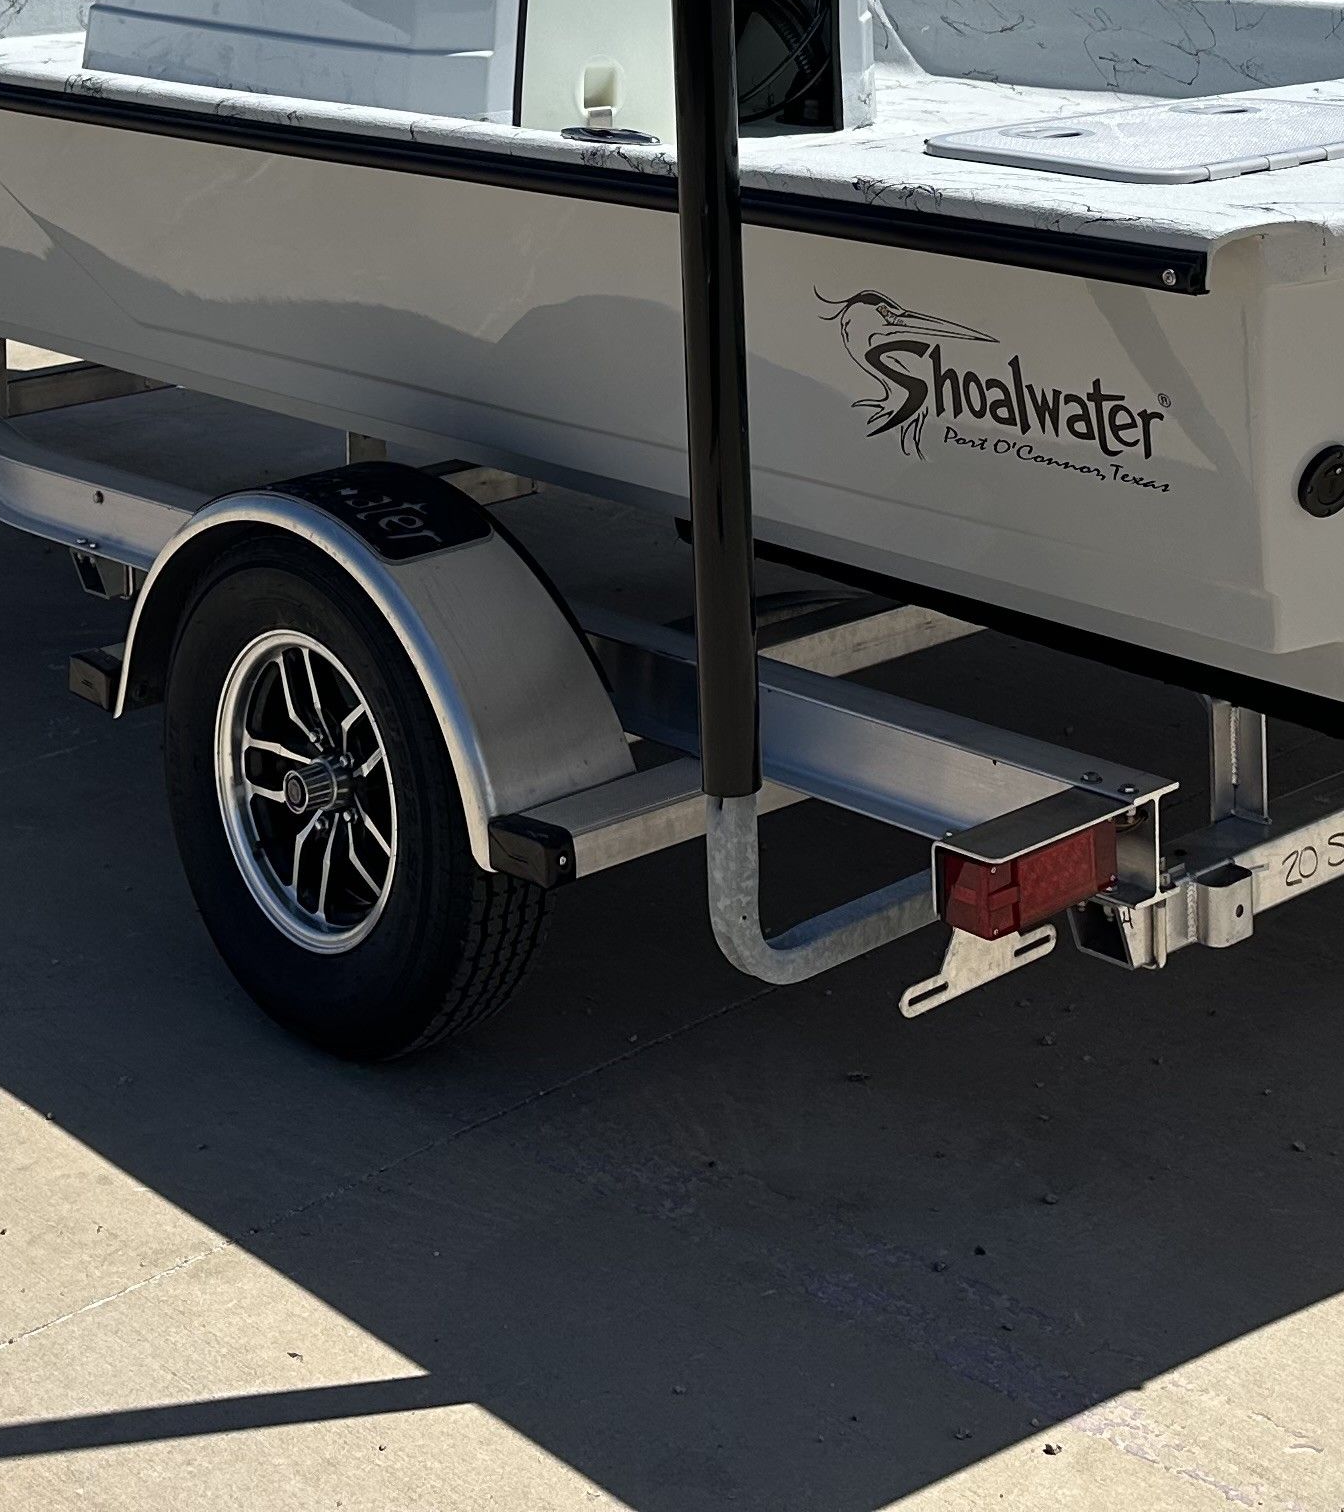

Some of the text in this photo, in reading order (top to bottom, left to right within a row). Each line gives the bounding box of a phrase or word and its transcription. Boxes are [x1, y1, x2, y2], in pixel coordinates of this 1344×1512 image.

[864, 339, 1165, 459] Shoalwater
[943, 426, 987, 452] Port
[1109, 464, 1170, 493] Texas
[1282, 845, 1318, 887] 20
